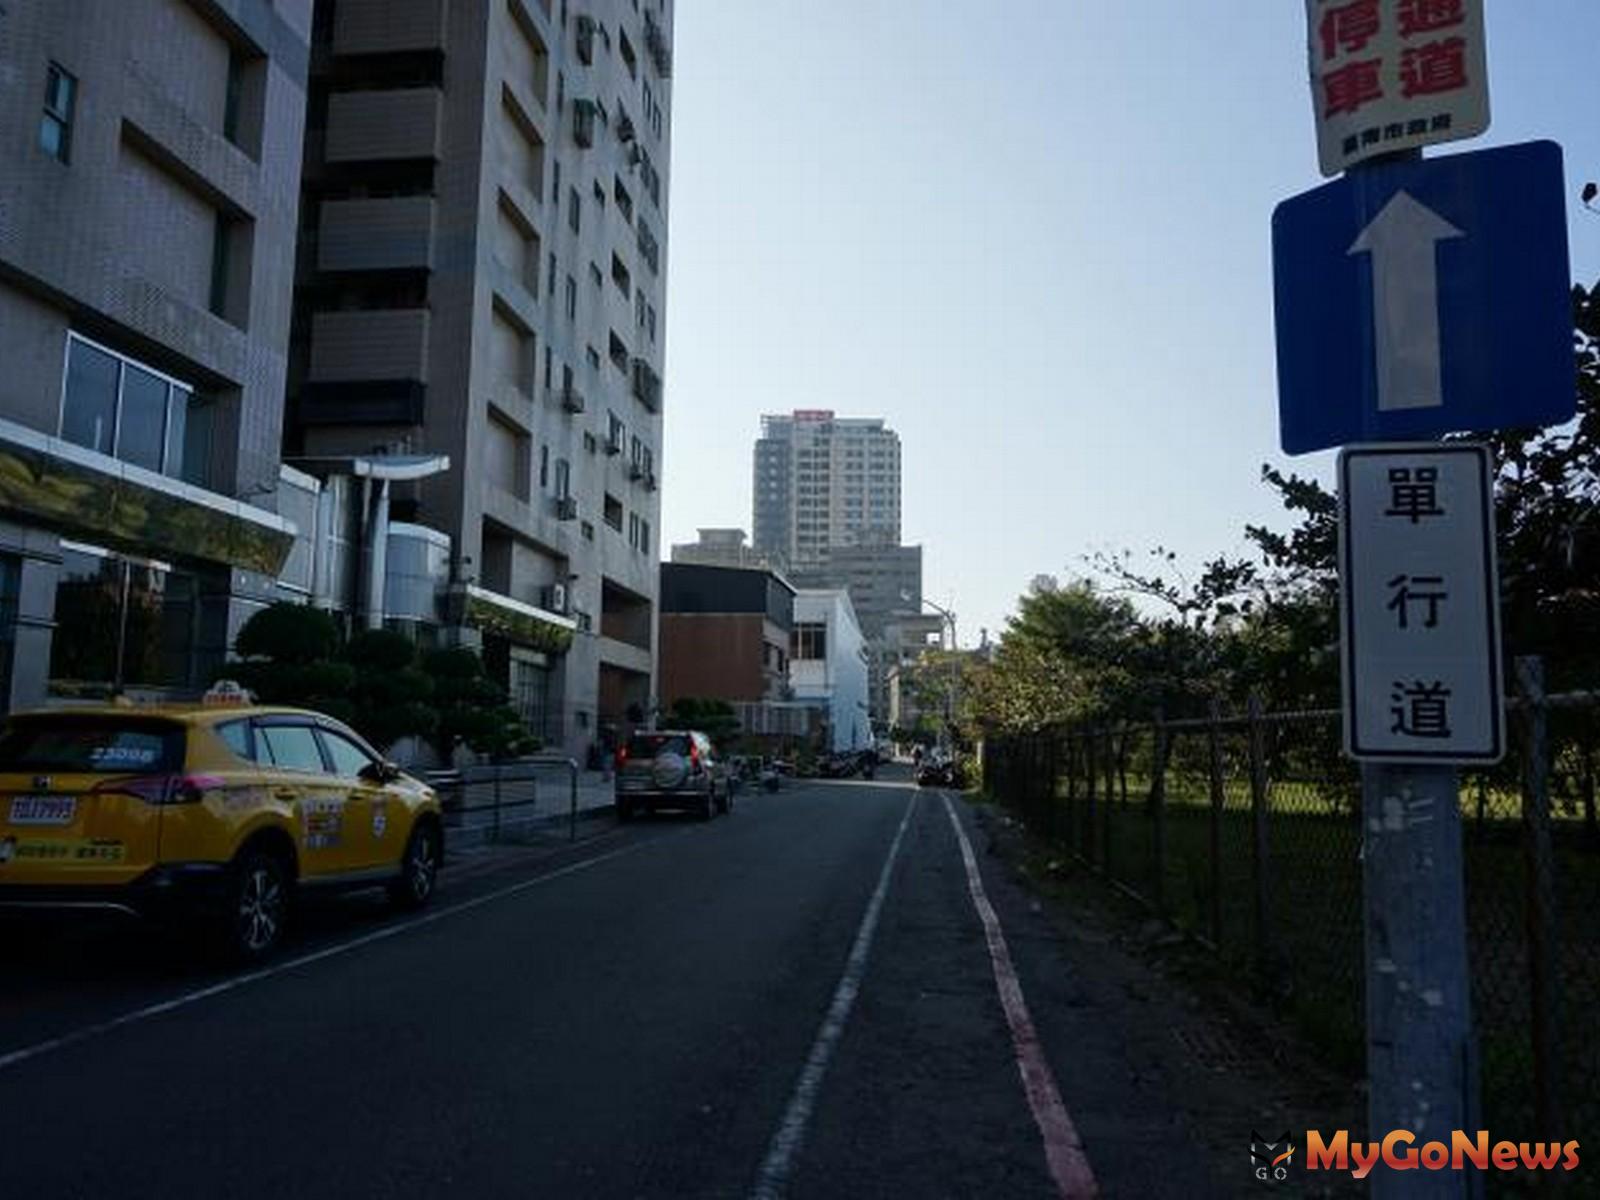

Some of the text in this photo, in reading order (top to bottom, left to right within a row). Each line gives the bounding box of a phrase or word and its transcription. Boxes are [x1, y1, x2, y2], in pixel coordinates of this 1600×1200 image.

[1321, 0, 1383, 119] 停車
[1384, 467, 1451, 738] 單行道
